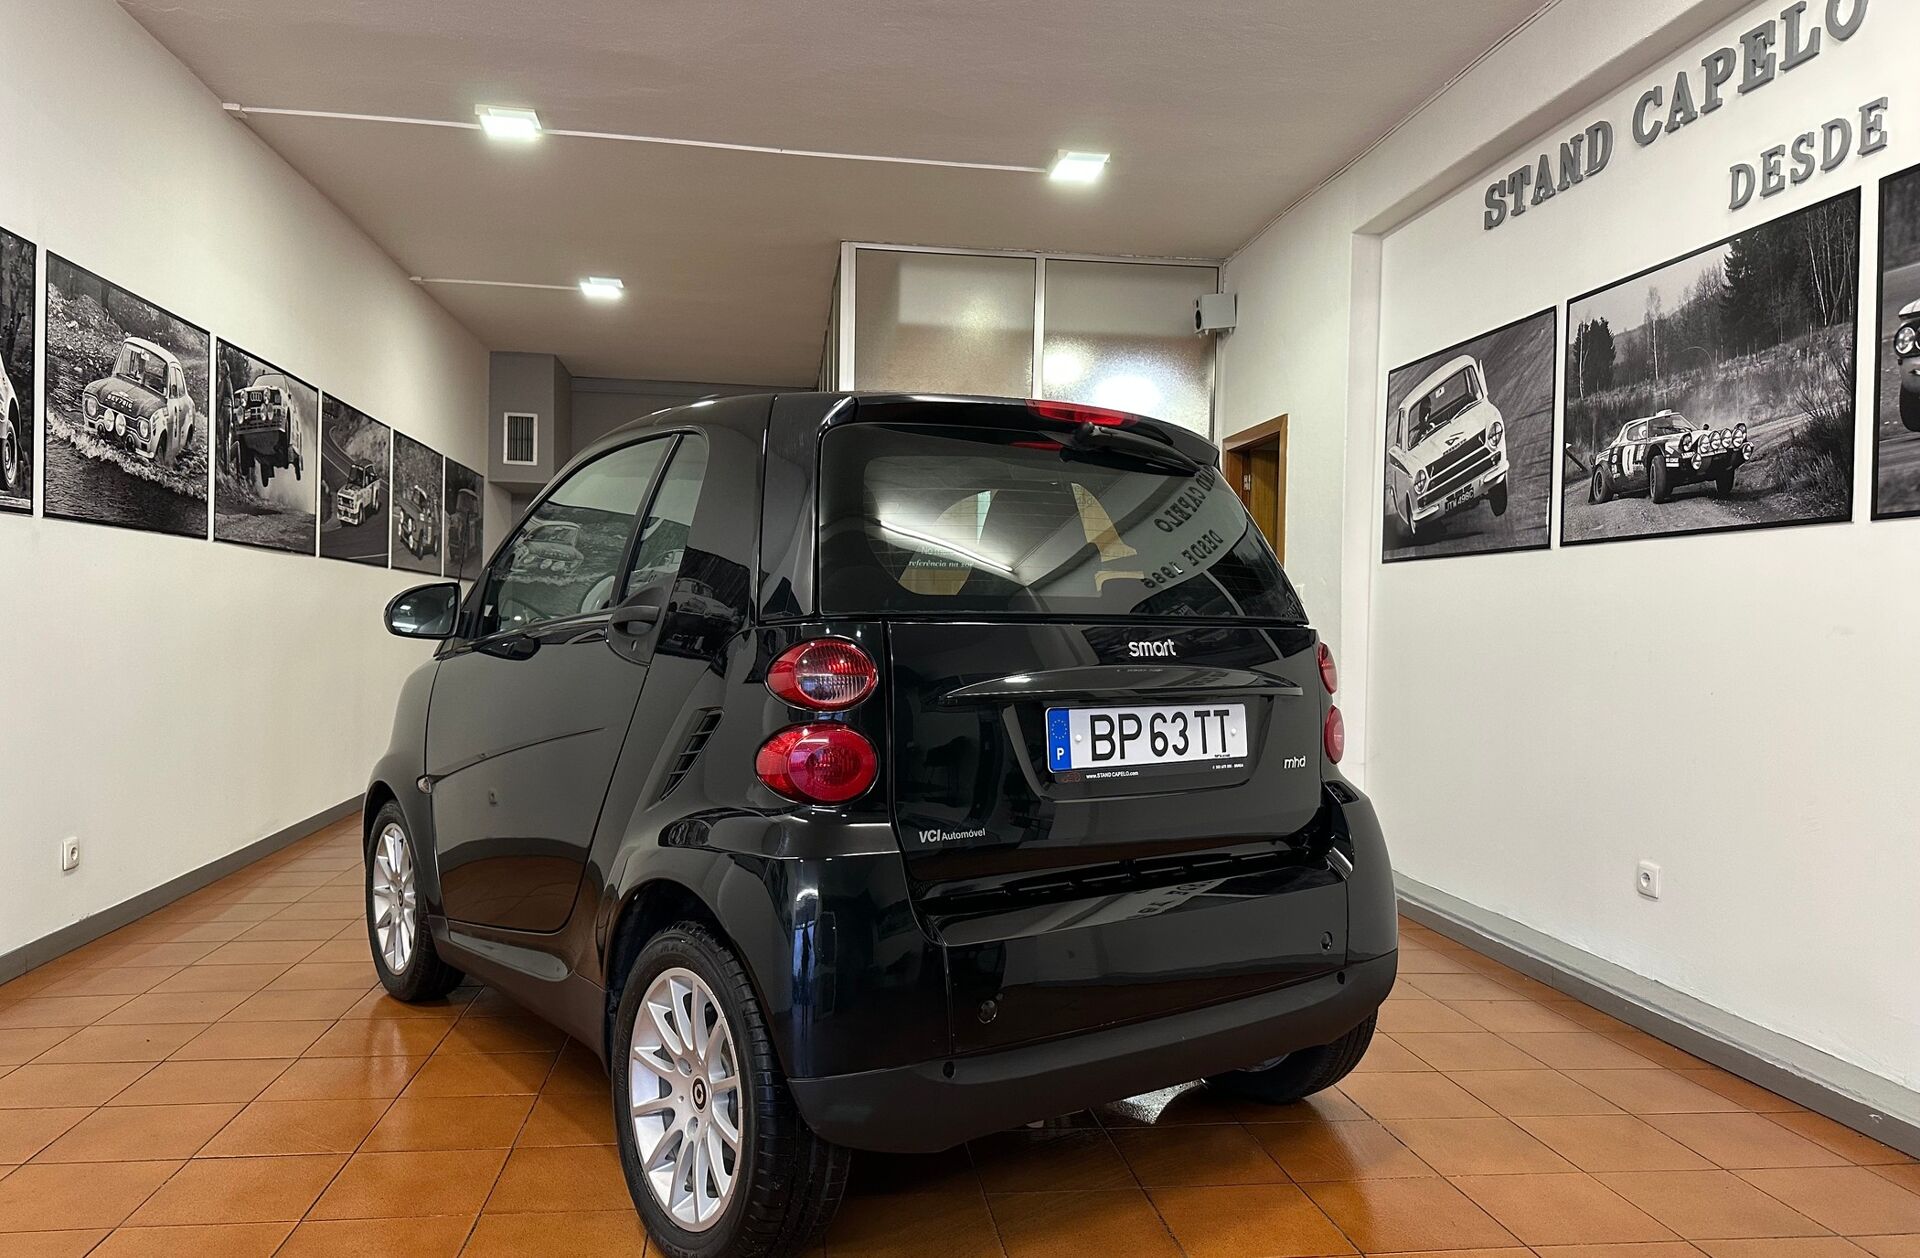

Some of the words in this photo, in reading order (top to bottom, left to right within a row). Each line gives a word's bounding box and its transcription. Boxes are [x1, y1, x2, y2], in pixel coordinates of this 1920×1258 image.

[1483, 119, 1614, 231] STAND
[1632, 0, 1869, 147] CAPELO
[1728, 96, 1889, 211] DESDE
[1128, 639, 1177, 657] smart
[1089, 713, 1143, 762] BP
[1149, 711, 1190, 758] 63
[1193, 709, 1230, 755] TT
[1056, 747, 1065, 761] P
[1283, 755, 1306, 769] mhd
[918, 829, 941, 843] VCI
[941, 827, 986, 841] Automóvel
